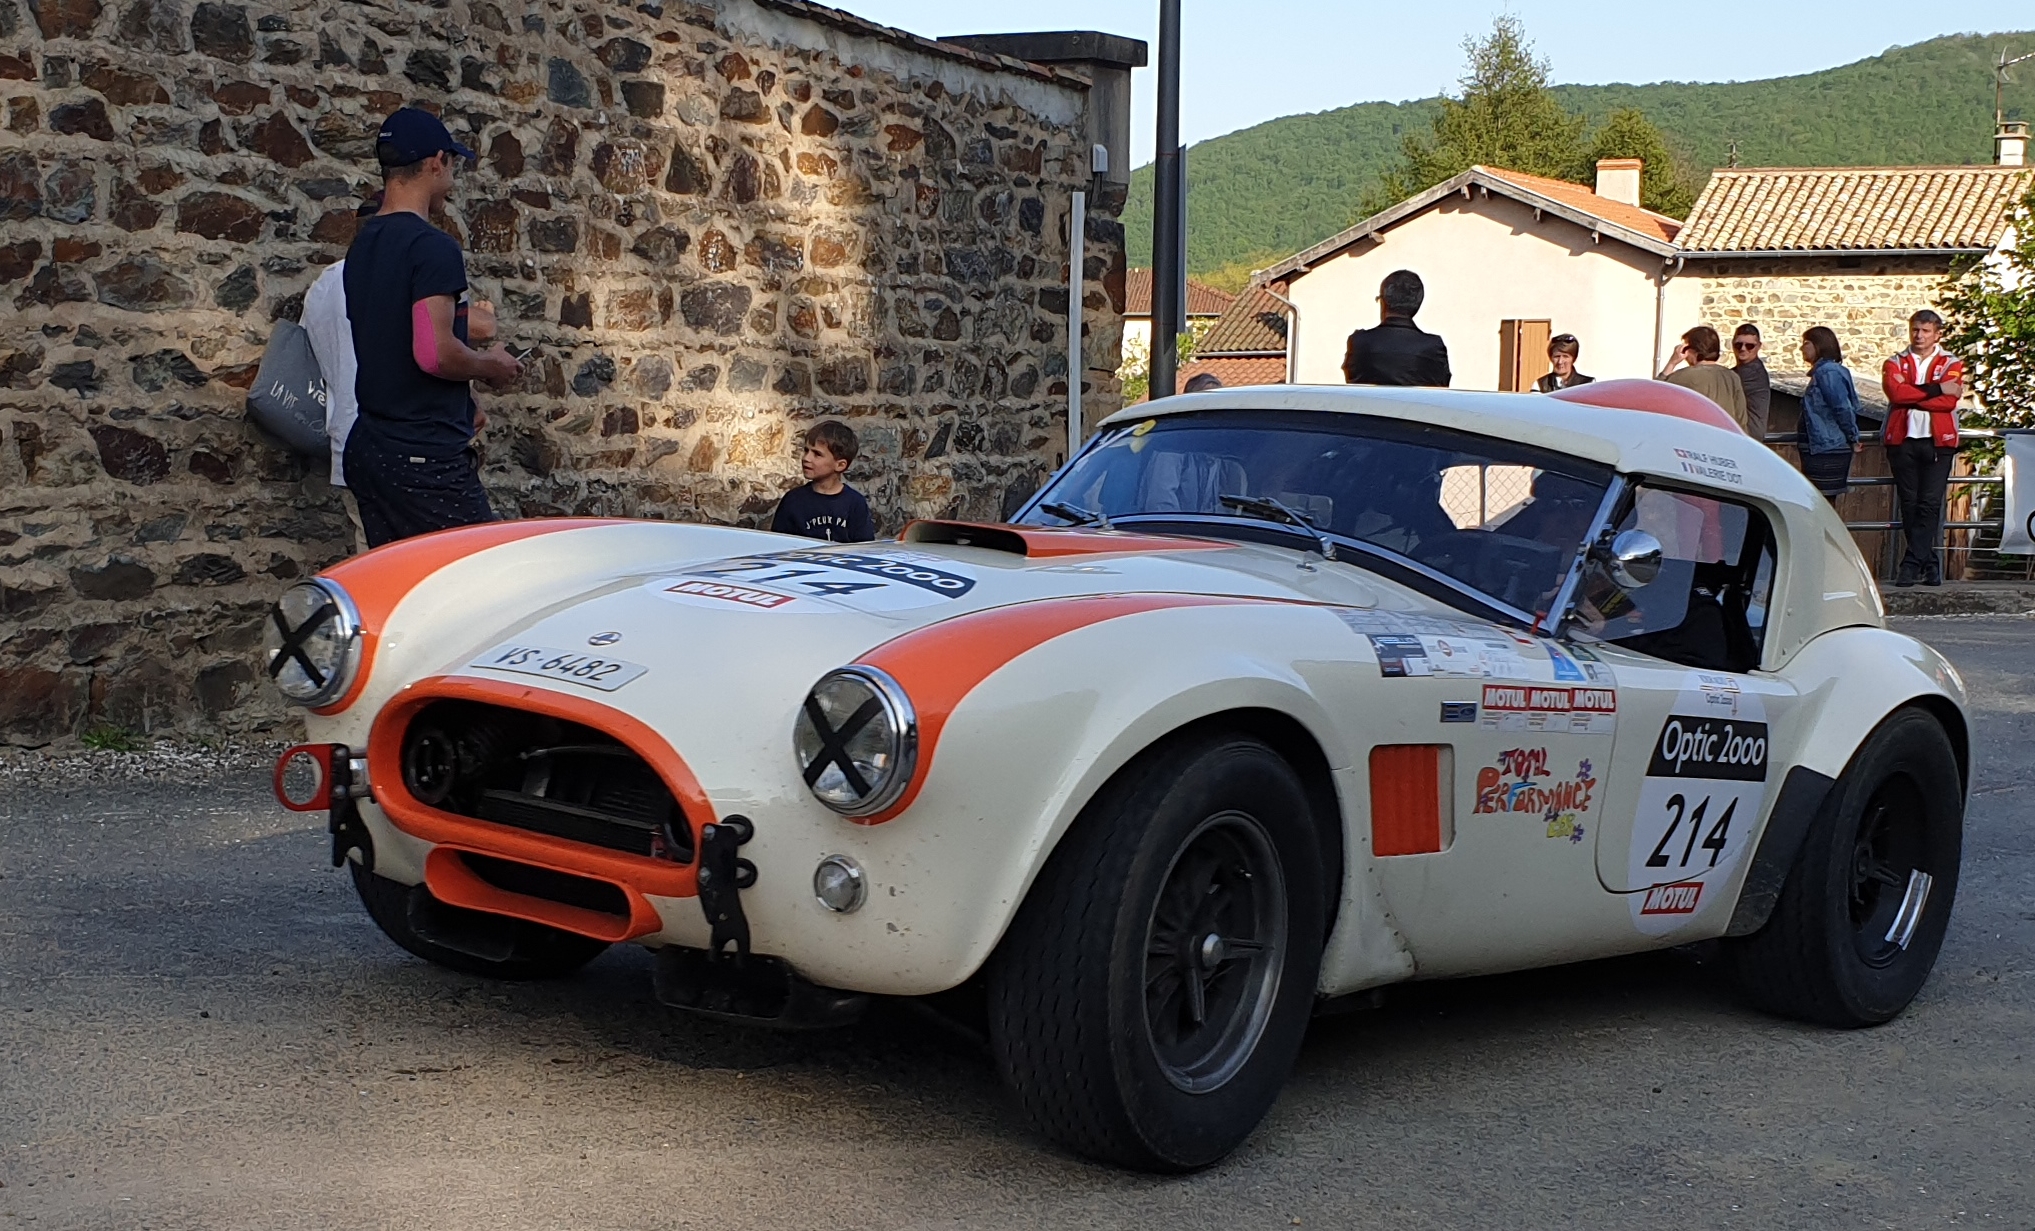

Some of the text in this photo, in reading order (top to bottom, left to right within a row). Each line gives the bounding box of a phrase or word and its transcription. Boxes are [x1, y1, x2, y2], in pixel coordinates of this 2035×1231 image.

[682, 562, 890, 597] 214
[857, 560, 966, 589] 2000
[672, 582, 782, 606] MOTUL
[1484, 688, 1615, 709] MOTUL MOTUL MOTUL
[1662, 720, 1766, 774] Optic 2000
[1645, 793, 1739, 868] 214
[1644, 886, 1699, 910] MOTUL
